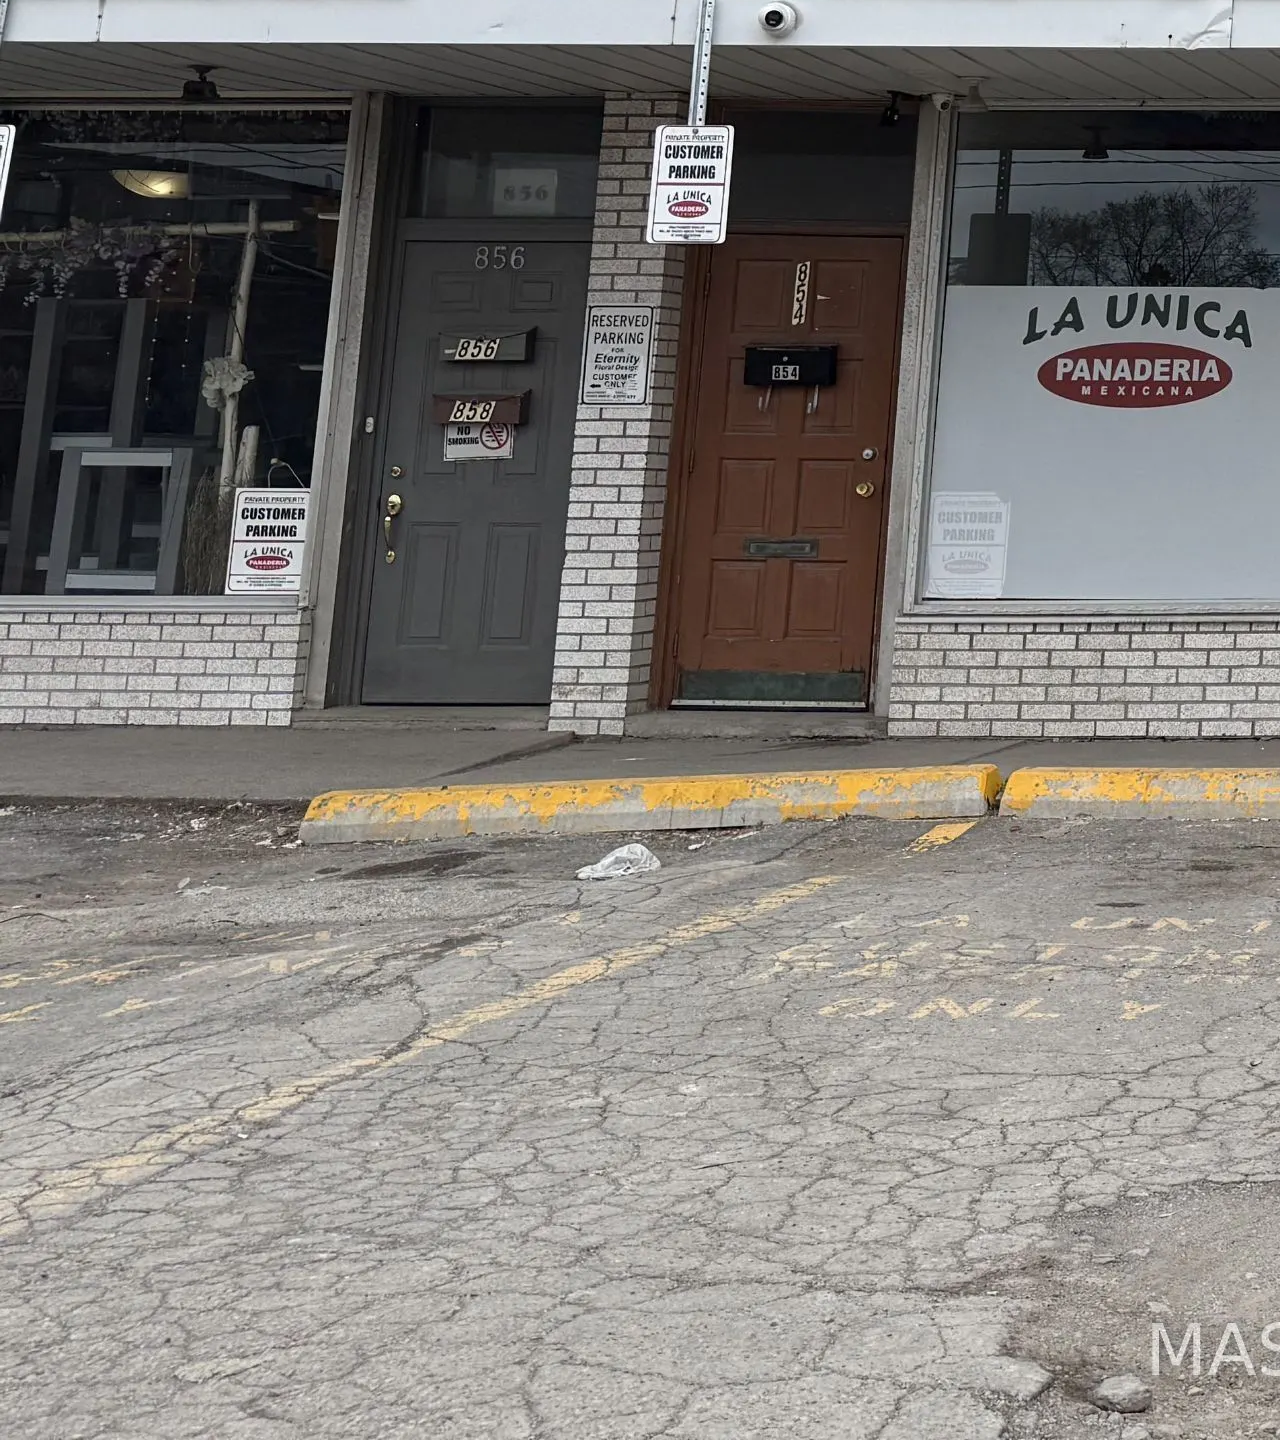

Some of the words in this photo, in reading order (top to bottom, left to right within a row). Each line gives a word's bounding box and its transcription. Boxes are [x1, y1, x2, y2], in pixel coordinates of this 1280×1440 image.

[665, 145, 723, 159] CUSTOMER
[668, 165, 715, 179] PARKING
[667, 191, 678, 204] LA
[683, 191, 711, 205] UNICA
[475, 246, 525, 269] 856
[793, 263, 808, 323] 854
[592, 315, 649, 327] RESERVED
[1023, 297, 1084, 345] LA
[1106, 292, 1252, 348] UNICA
[594, 332, 644, 344] PARKING
[457, 340, 497, 358] 856
[594, 353, 640, 365] Eternity
[774, 367, 797, 379] 854
[1056, 358, 1221, 382] PANADERIA
[1081, 385, 1193, 396] MEXICANA
[453, 403, 492, 420] 858
[457, 426, 471, 436] NO
[448, 436, 480, 446] SMOKING
[241, 508, 305, 520] CUSTOMER
[938, 512, 1002, 524] CUSTOMER
[246, 525, 297, 537] PARKING
[943, 528, 995, 540] PARKING
[244, 547, 257, 558] LA
[262, 547, 293, 559] UNICA
